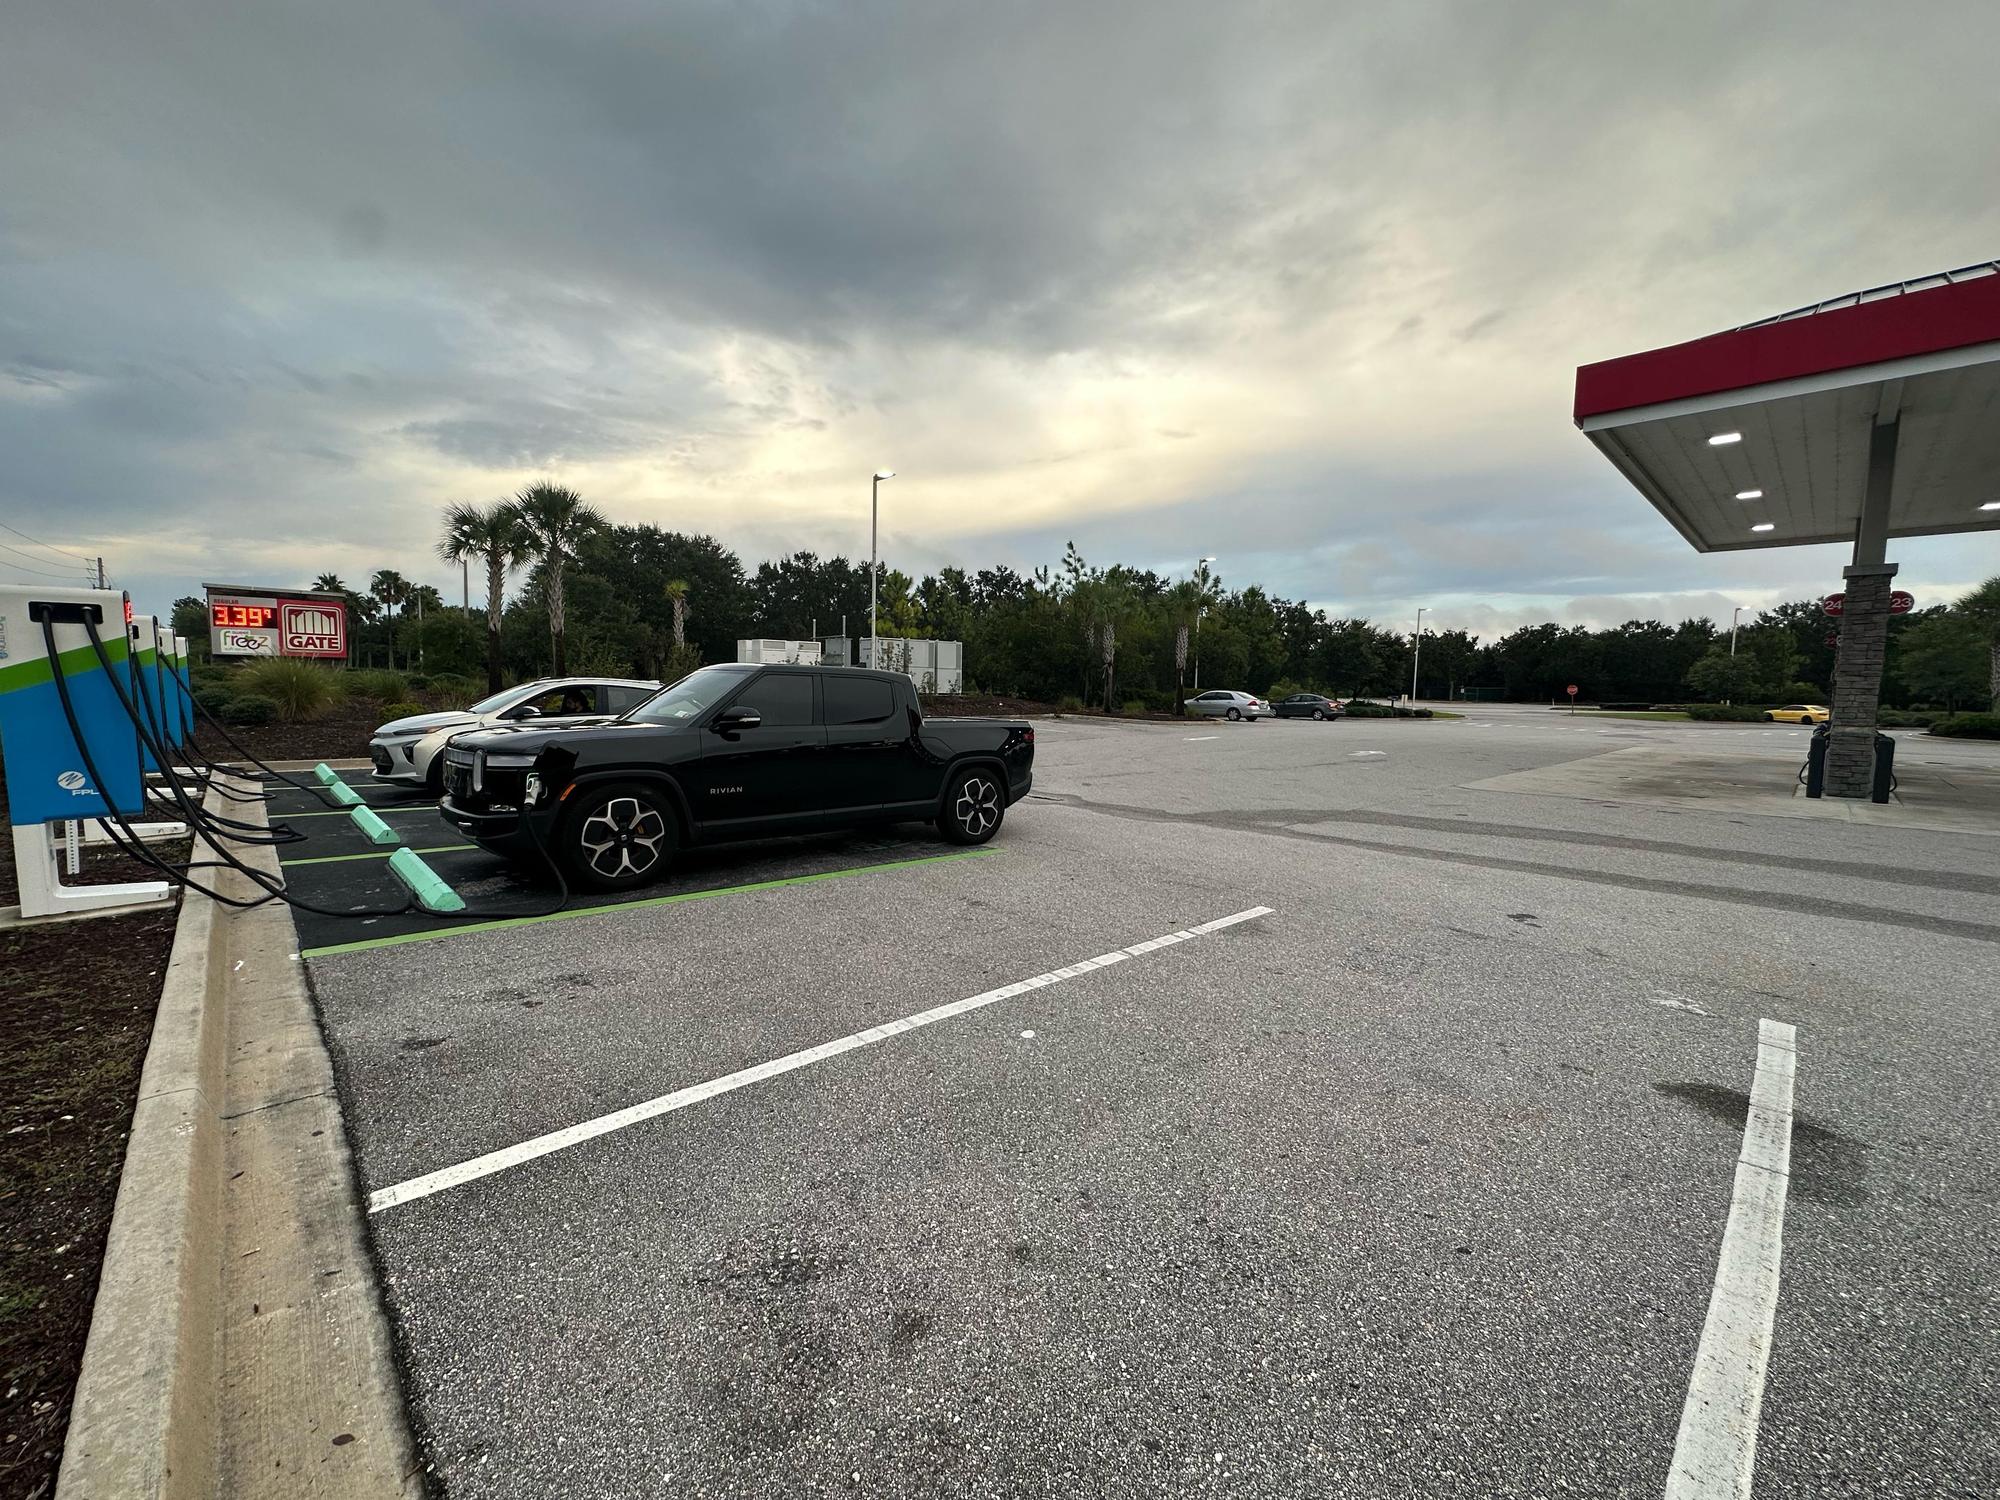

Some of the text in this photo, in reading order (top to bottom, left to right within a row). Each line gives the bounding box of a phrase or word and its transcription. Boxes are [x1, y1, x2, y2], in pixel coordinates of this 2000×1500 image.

[1824, 600, 1842, 610] 24
[1891, 598, 1911, 608] 23
[288, 635, 339, 649] GATE
[710, 786, 743, 795] RIVIAN
